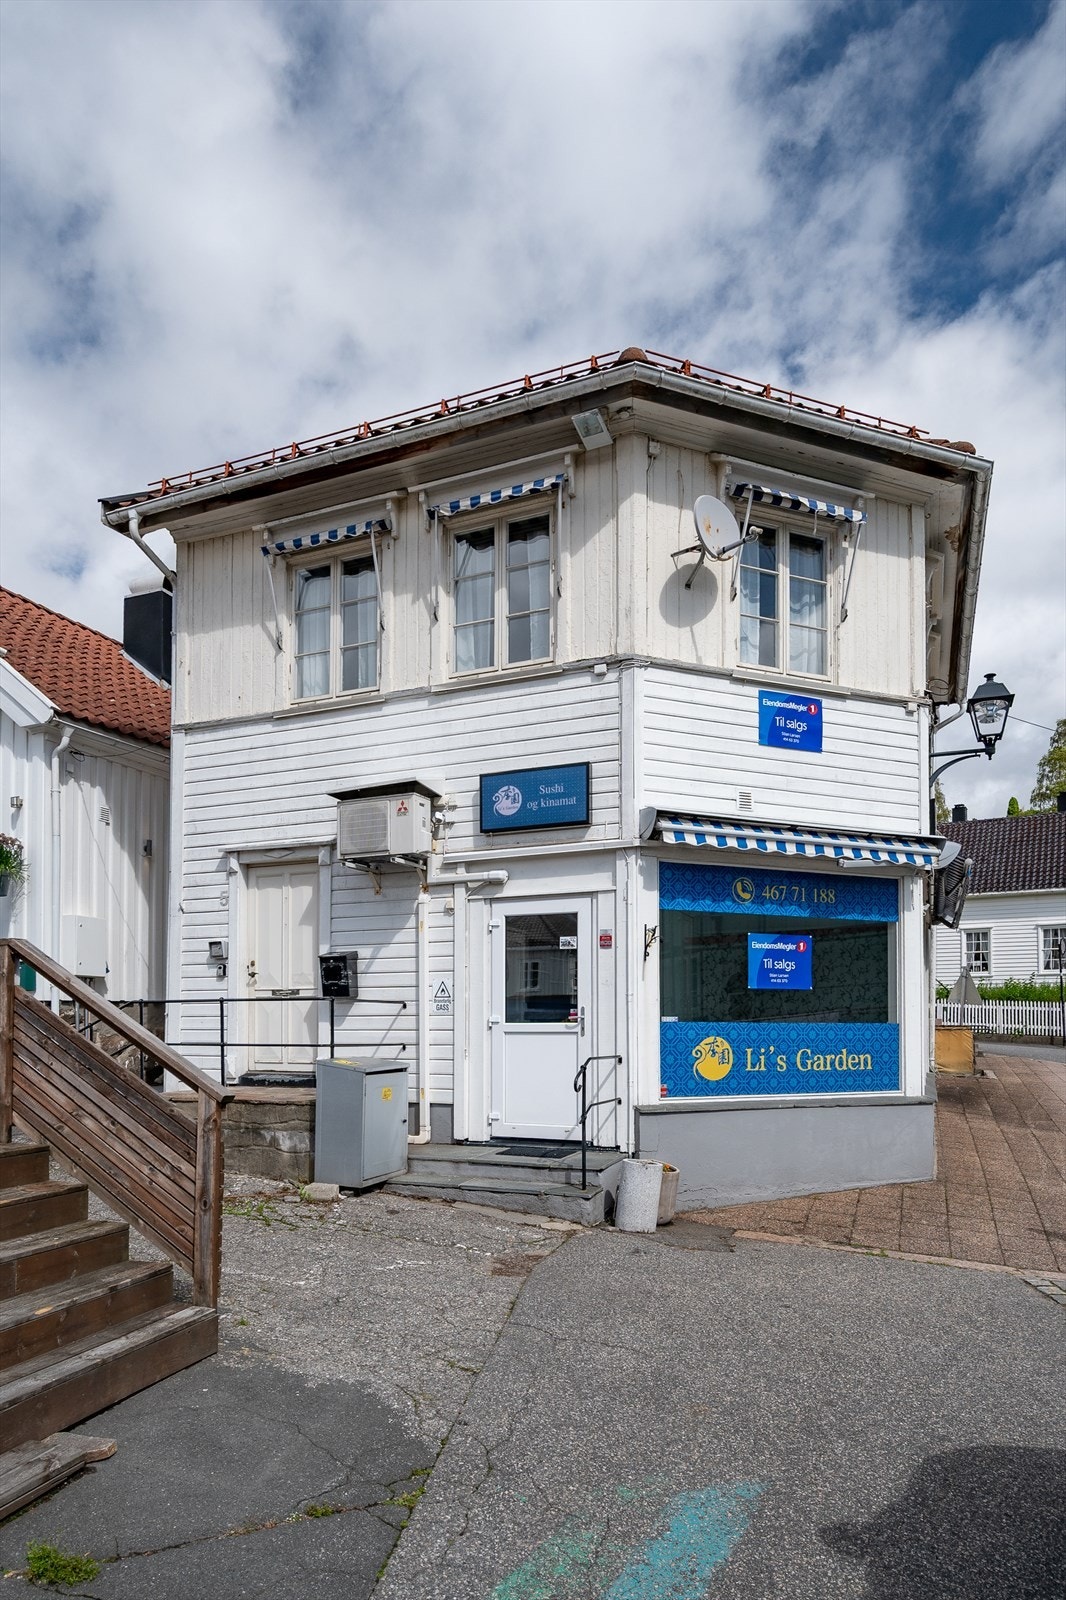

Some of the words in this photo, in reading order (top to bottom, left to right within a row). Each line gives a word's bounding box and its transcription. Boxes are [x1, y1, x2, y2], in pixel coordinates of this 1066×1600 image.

[763, 698, 807, 712] EiendomsMegler
[775, 717, 785, 727] Til
[786, 719, 808, 732] salgs
[540, 783, 564, 794] Sushi
[527, 801, 538, 810] og
[540, 797, 576, 808] kinamat
[219, 891, 229, 906] 5
[761, 885, 787, 901] 467
[791, 886, 806, 902] 71
[813, 888, 836, 904] 188
[751, 941, 797, 952] EiendomsMegler
[763, 958, 773, 969] Til
[774, 958, 796, 972] salgs
[745, 1045, 787, 1072] Li's
[796, 1047, 873, 1072] Garden
